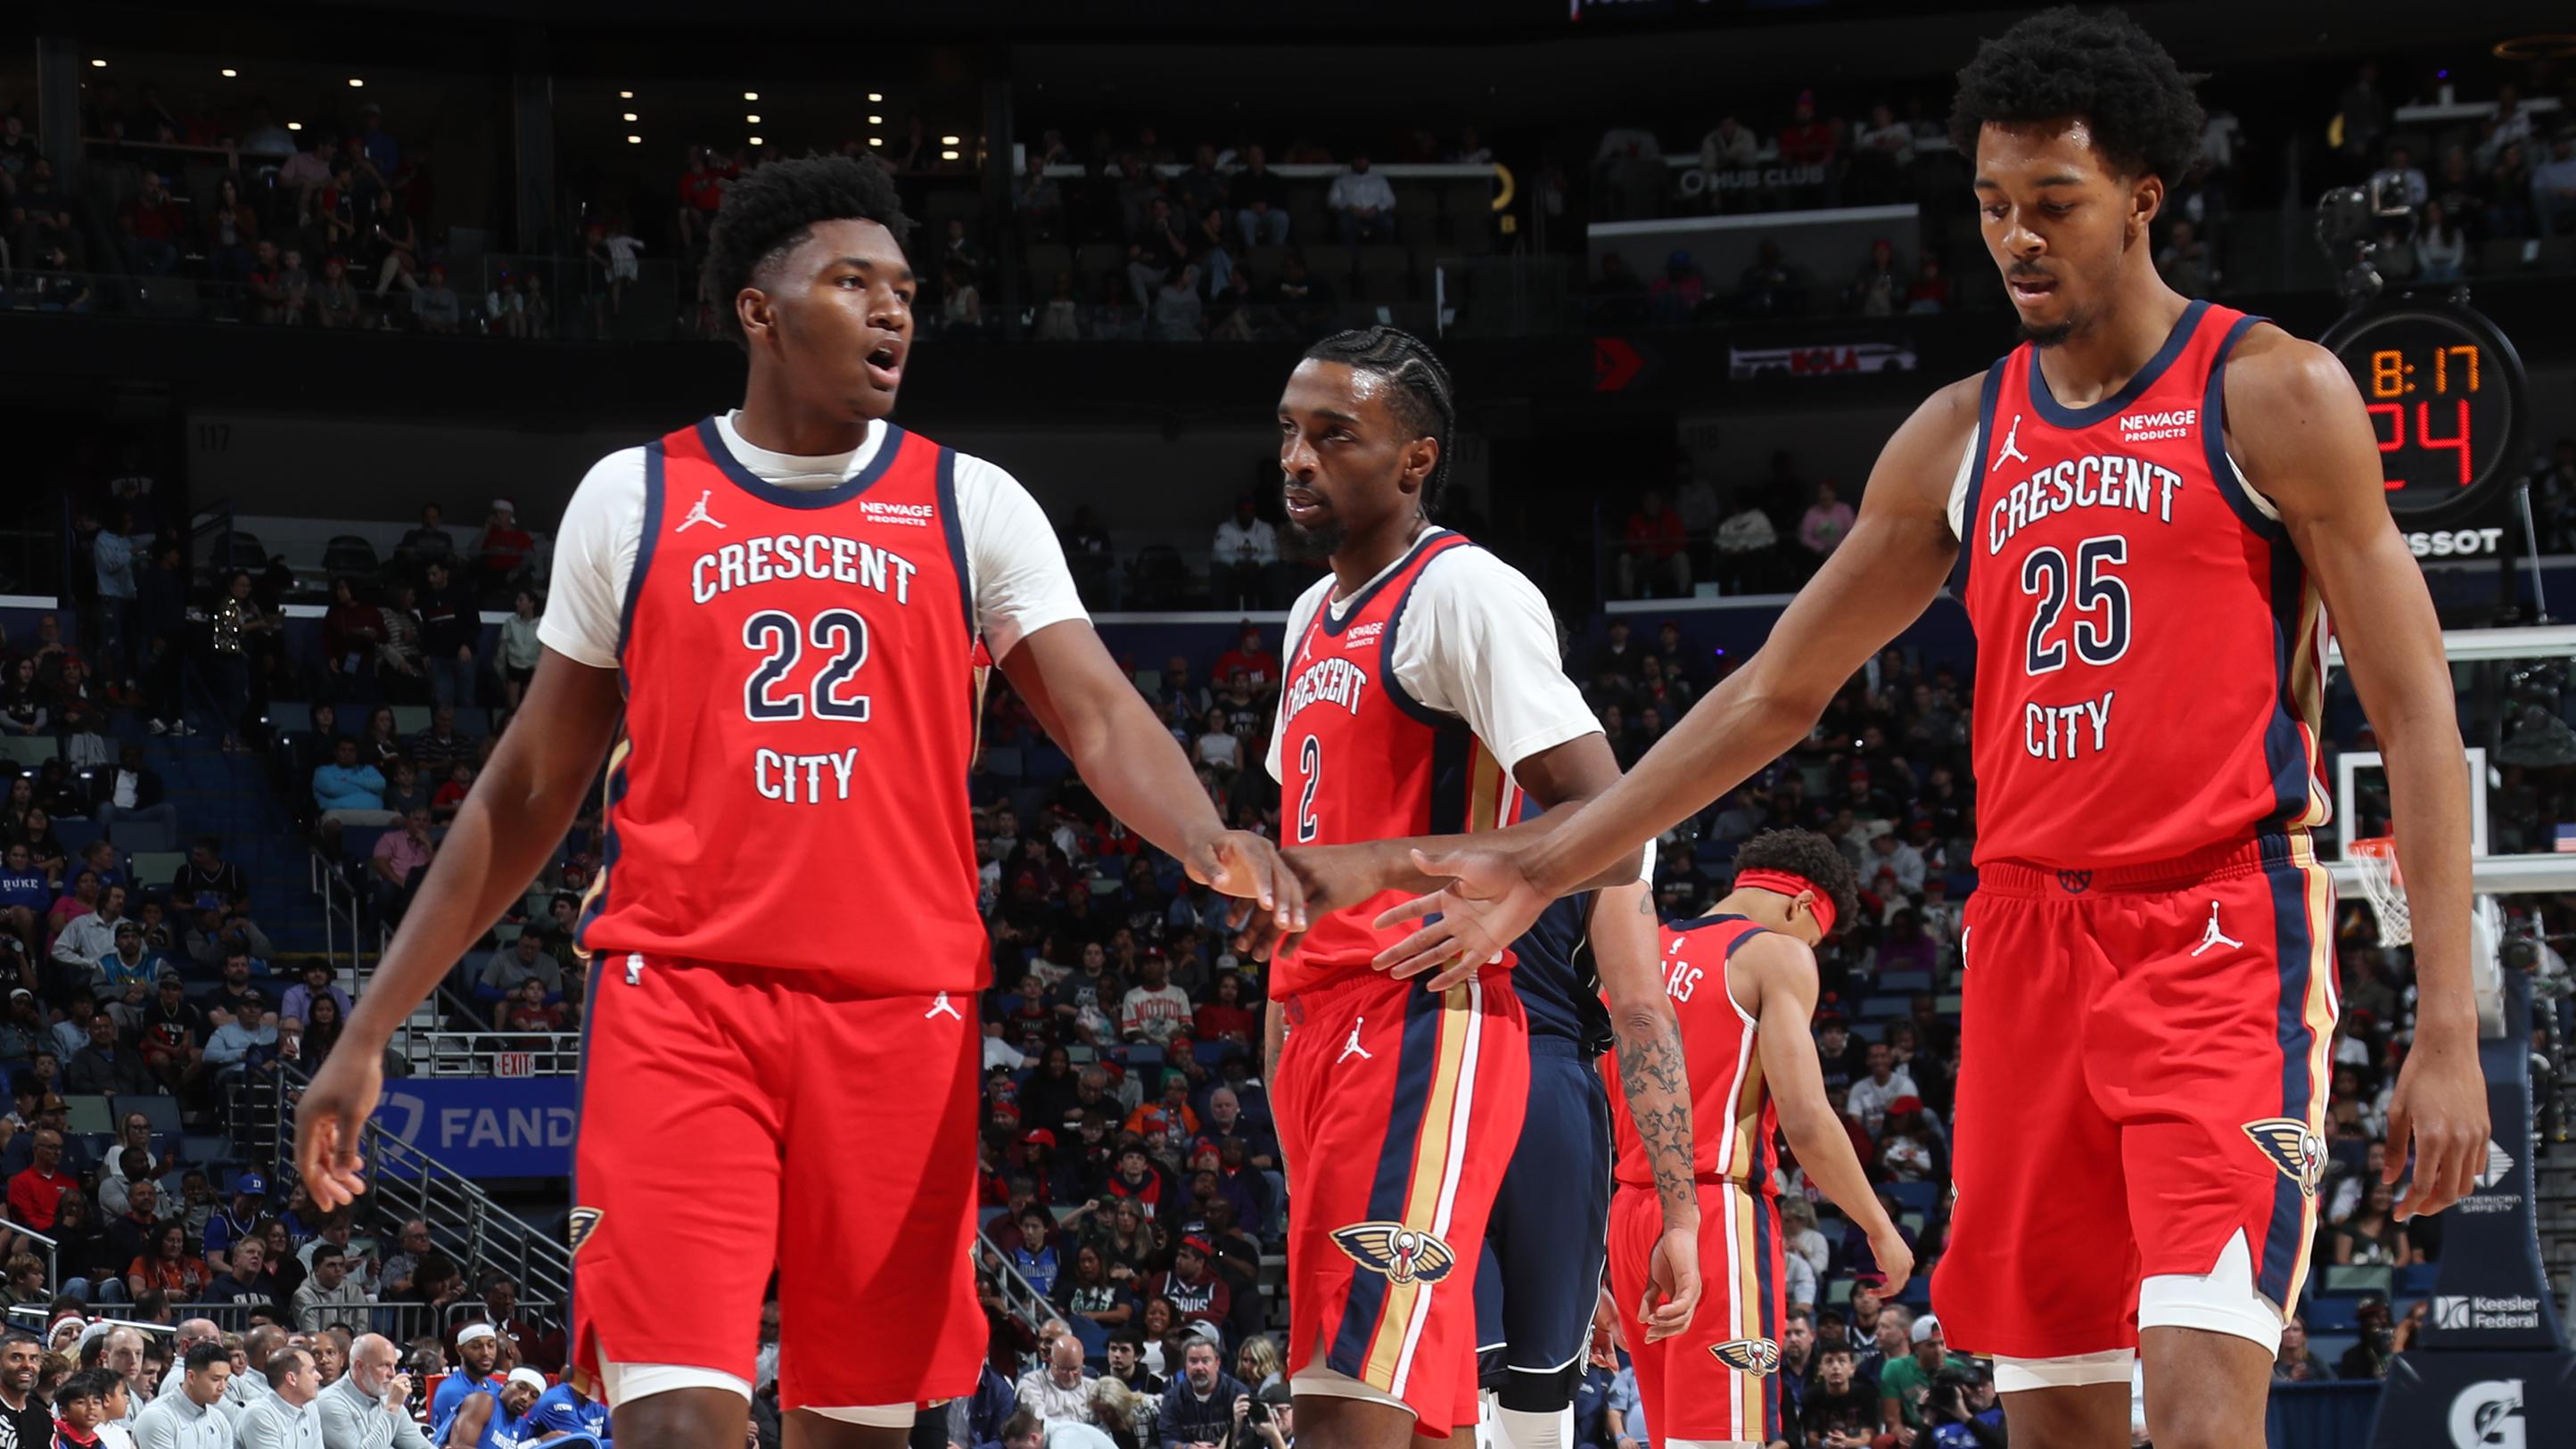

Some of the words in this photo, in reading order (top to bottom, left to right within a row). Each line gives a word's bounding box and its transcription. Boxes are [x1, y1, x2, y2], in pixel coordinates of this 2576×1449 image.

[2372, 345, 2481, 398] 8:17
[2119, 409, 2196, 432] NEWAGE
[2125, 427, 2186, 442] PRODUCTS
[199, 424, 231, 449] 117
[860, 501, 934, 517] NEWAGE
[1989, 455, 2184, 556] CRESCENT
[867, 515, 927, 527] PRODUCTS
[2402, 528, 2503, 557] SSOT
[691, 533, 918, 605] CRESCENT
[2020, 534, 2132, 677] 25
[742, 607, 871, 723] 22
[1282, 657, 1368, 735] CRESCENT
[2025, 690, 2115, 761] CITY
[754, 747, 859, 804] CITY
[1297, 734, 1321, 844] 2
[3, 878, 38, 891] DUKE
[502, 1054, 529, 1076] EXIT
[2474, 1297, 2539, 1313] Keesler
[2474, 1313, 2539, 1329] Federal
